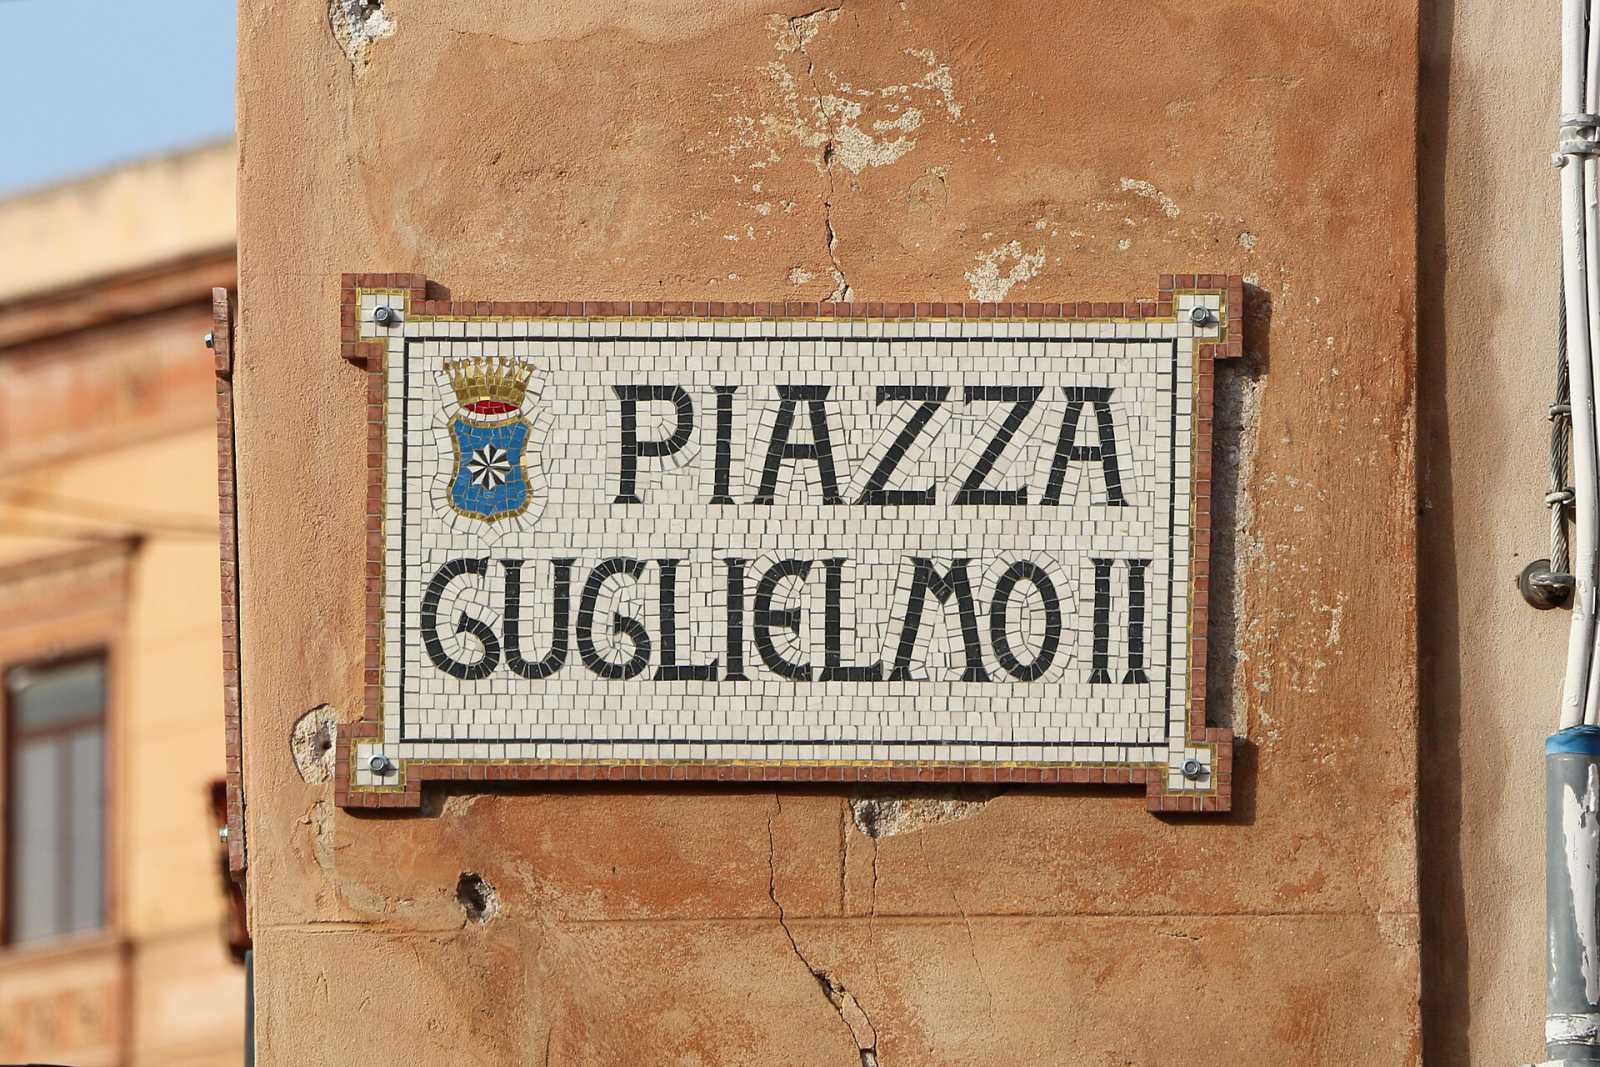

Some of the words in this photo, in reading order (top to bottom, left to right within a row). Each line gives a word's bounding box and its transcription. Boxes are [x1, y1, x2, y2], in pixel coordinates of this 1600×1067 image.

[612, 384, 1129, 506] PIAZZA
[420, 556, 1062, 682] GUGLIELMO
[1087, 557, 1152, 684] II
